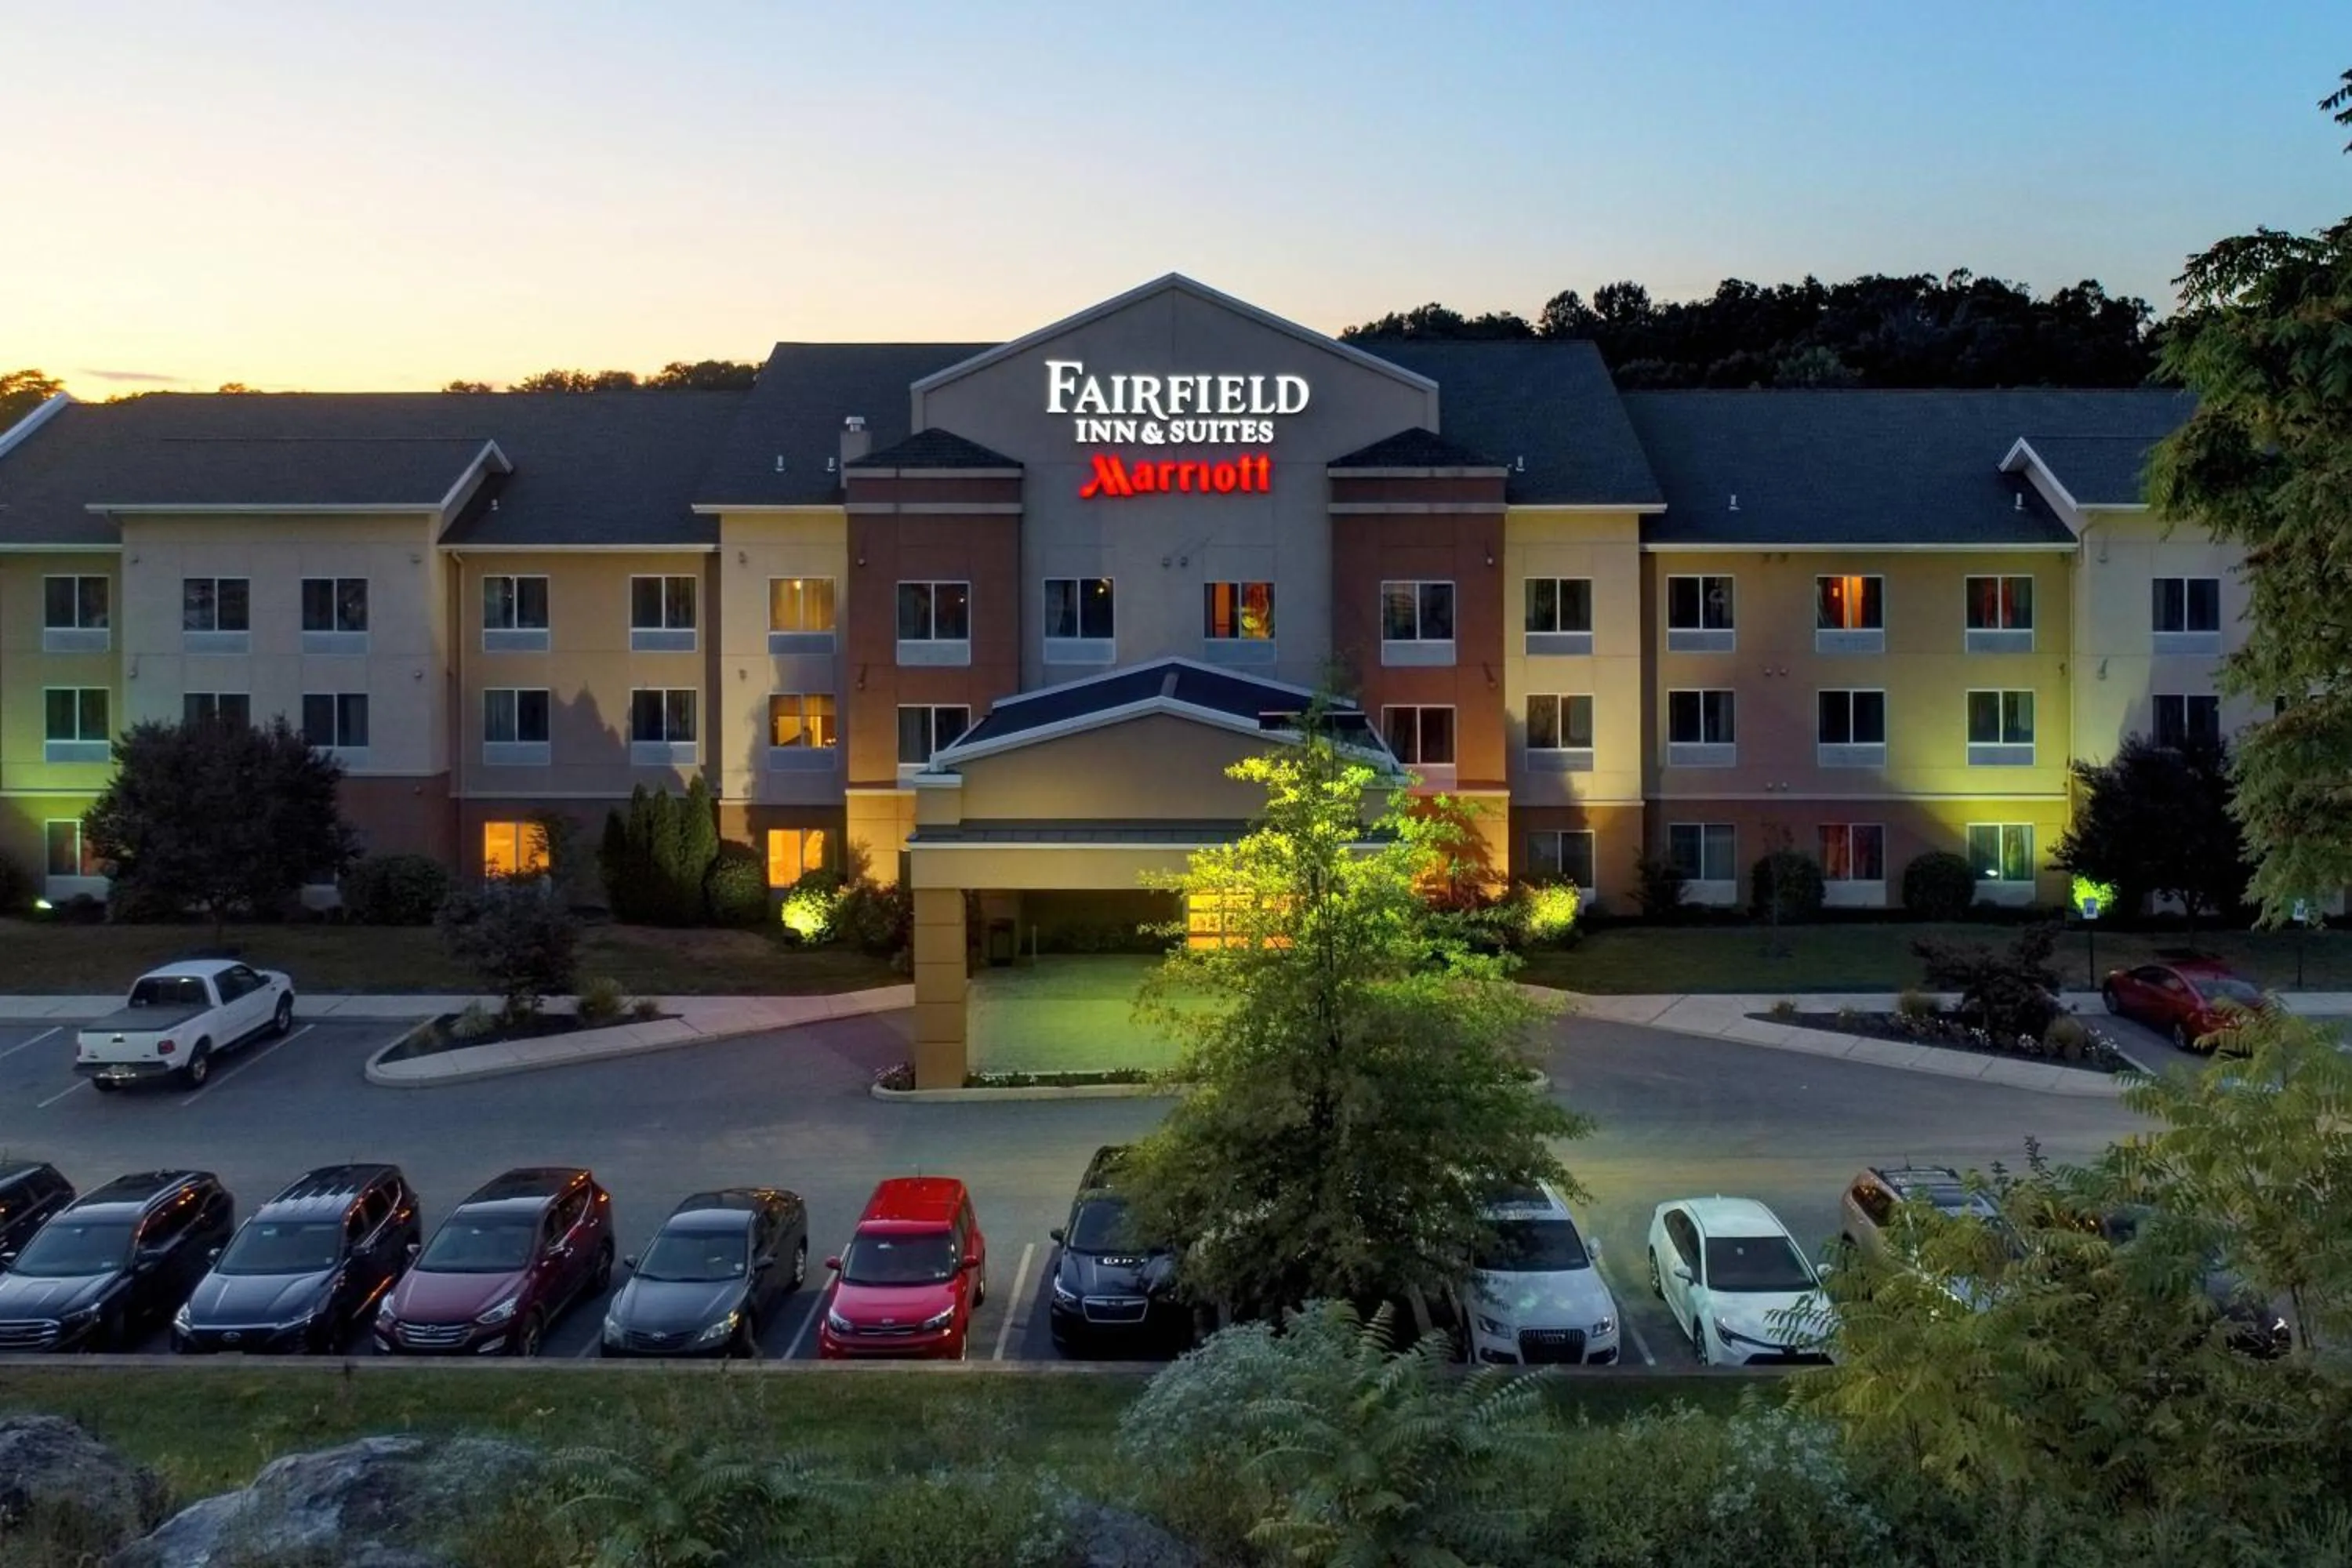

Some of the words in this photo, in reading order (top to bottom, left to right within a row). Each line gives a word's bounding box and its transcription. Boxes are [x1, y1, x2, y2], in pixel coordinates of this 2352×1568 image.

[1044, 360, 1310, 419] FAIRFIELD
[1075, 419, 1138, 443] INN
[1141, 420, 1166, 445] &
[1169, 419, 1274, 444] SUITES
[1079, 453, 1272, 498] Marriott
